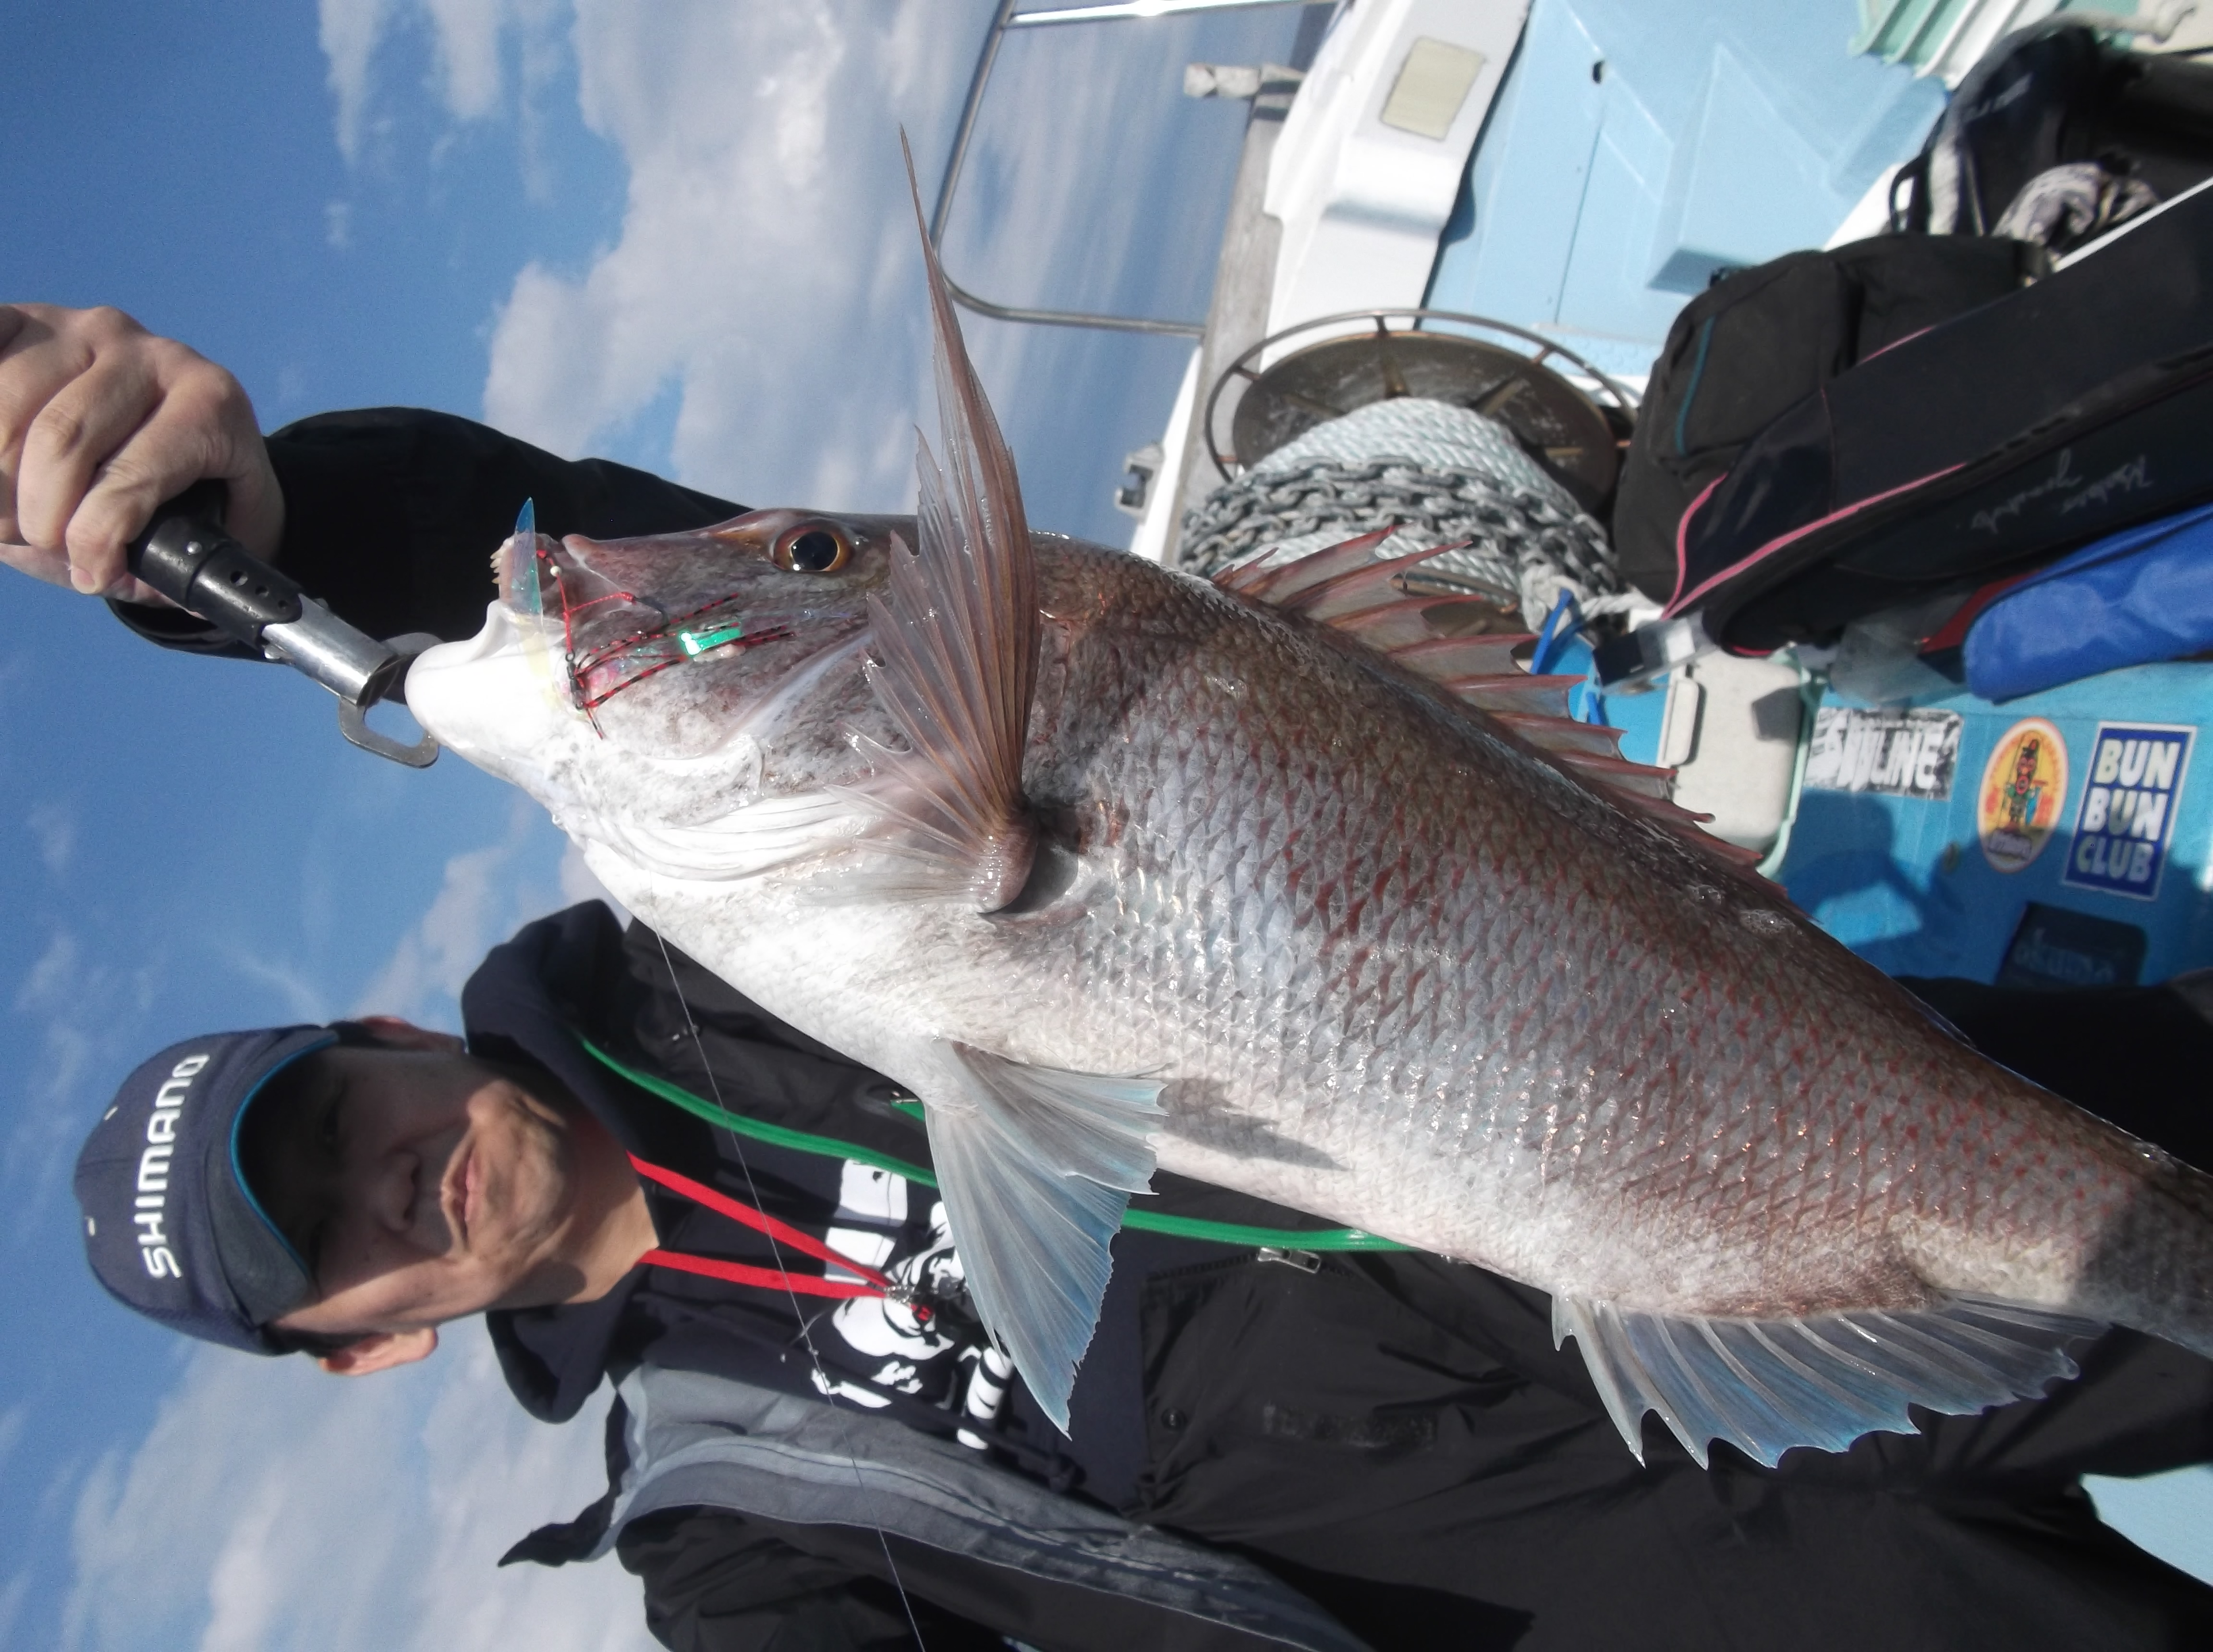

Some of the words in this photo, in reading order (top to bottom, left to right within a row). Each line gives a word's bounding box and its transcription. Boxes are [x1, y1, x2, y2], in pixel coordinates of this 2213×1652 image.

[2092, 739, 2181, 790] BUN
[2083, 787, 2169, 841] BUN
[2077, 835, 2154, 882] CLUB
[134, 1055, 210, 1278] SHIMANO
